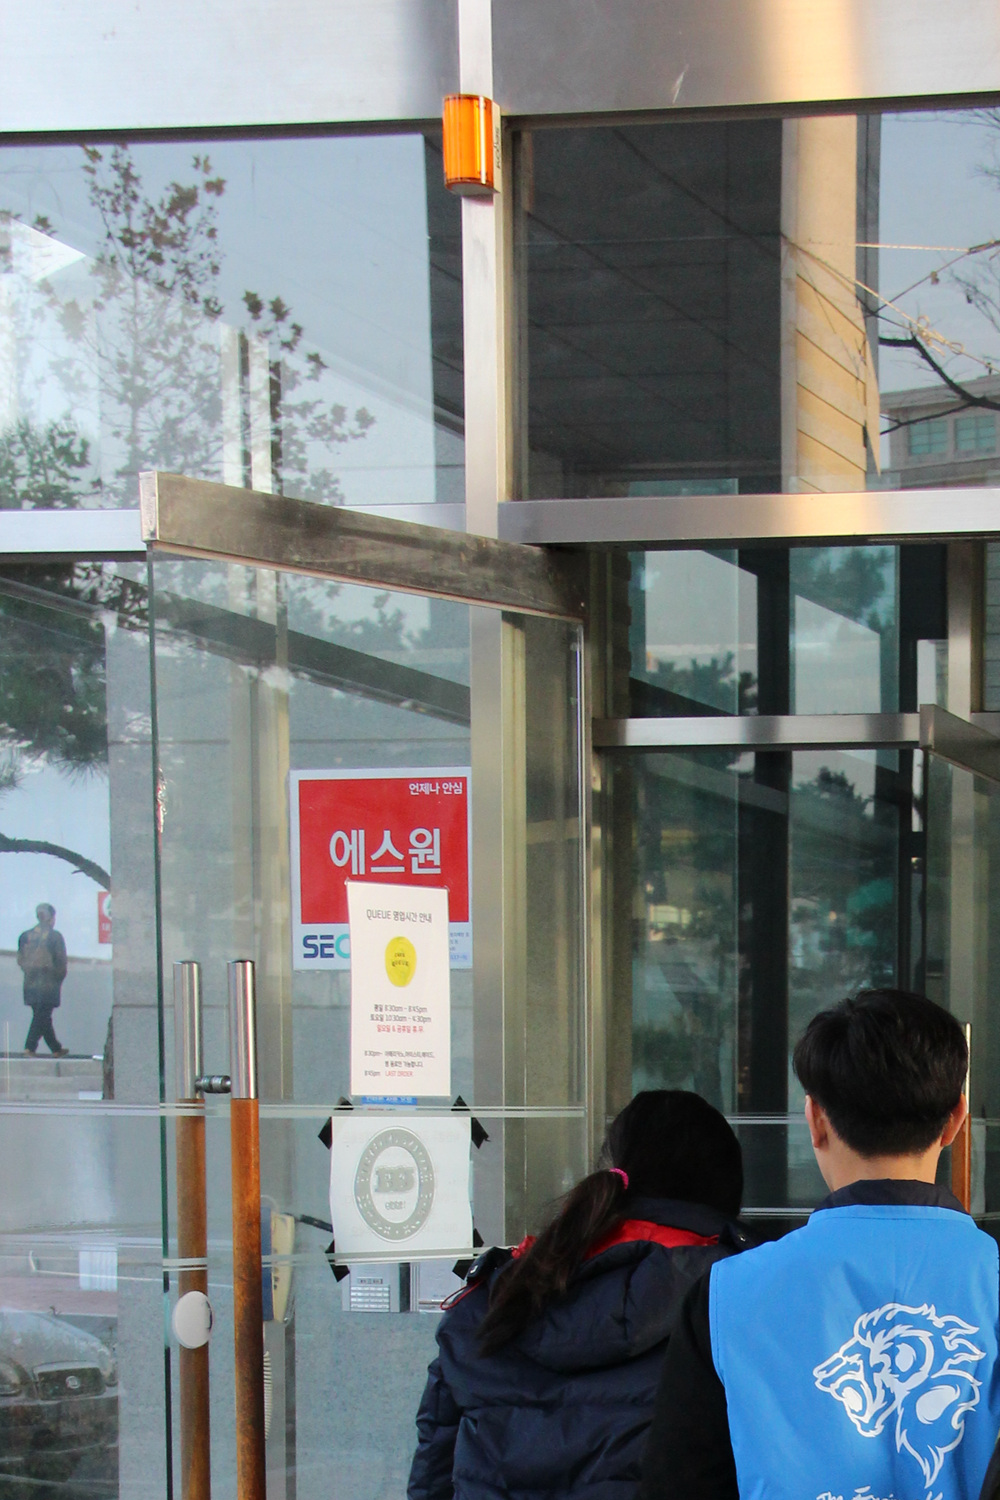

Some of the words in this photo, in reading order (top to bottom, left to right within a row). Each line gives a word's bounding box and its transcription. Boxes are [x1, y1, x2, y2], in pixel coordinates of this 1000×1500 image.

[409, 783, 440, 795] 언제나
[442, 782, 463, 794] 안심
[329, 828, 441, 875] 에스원
